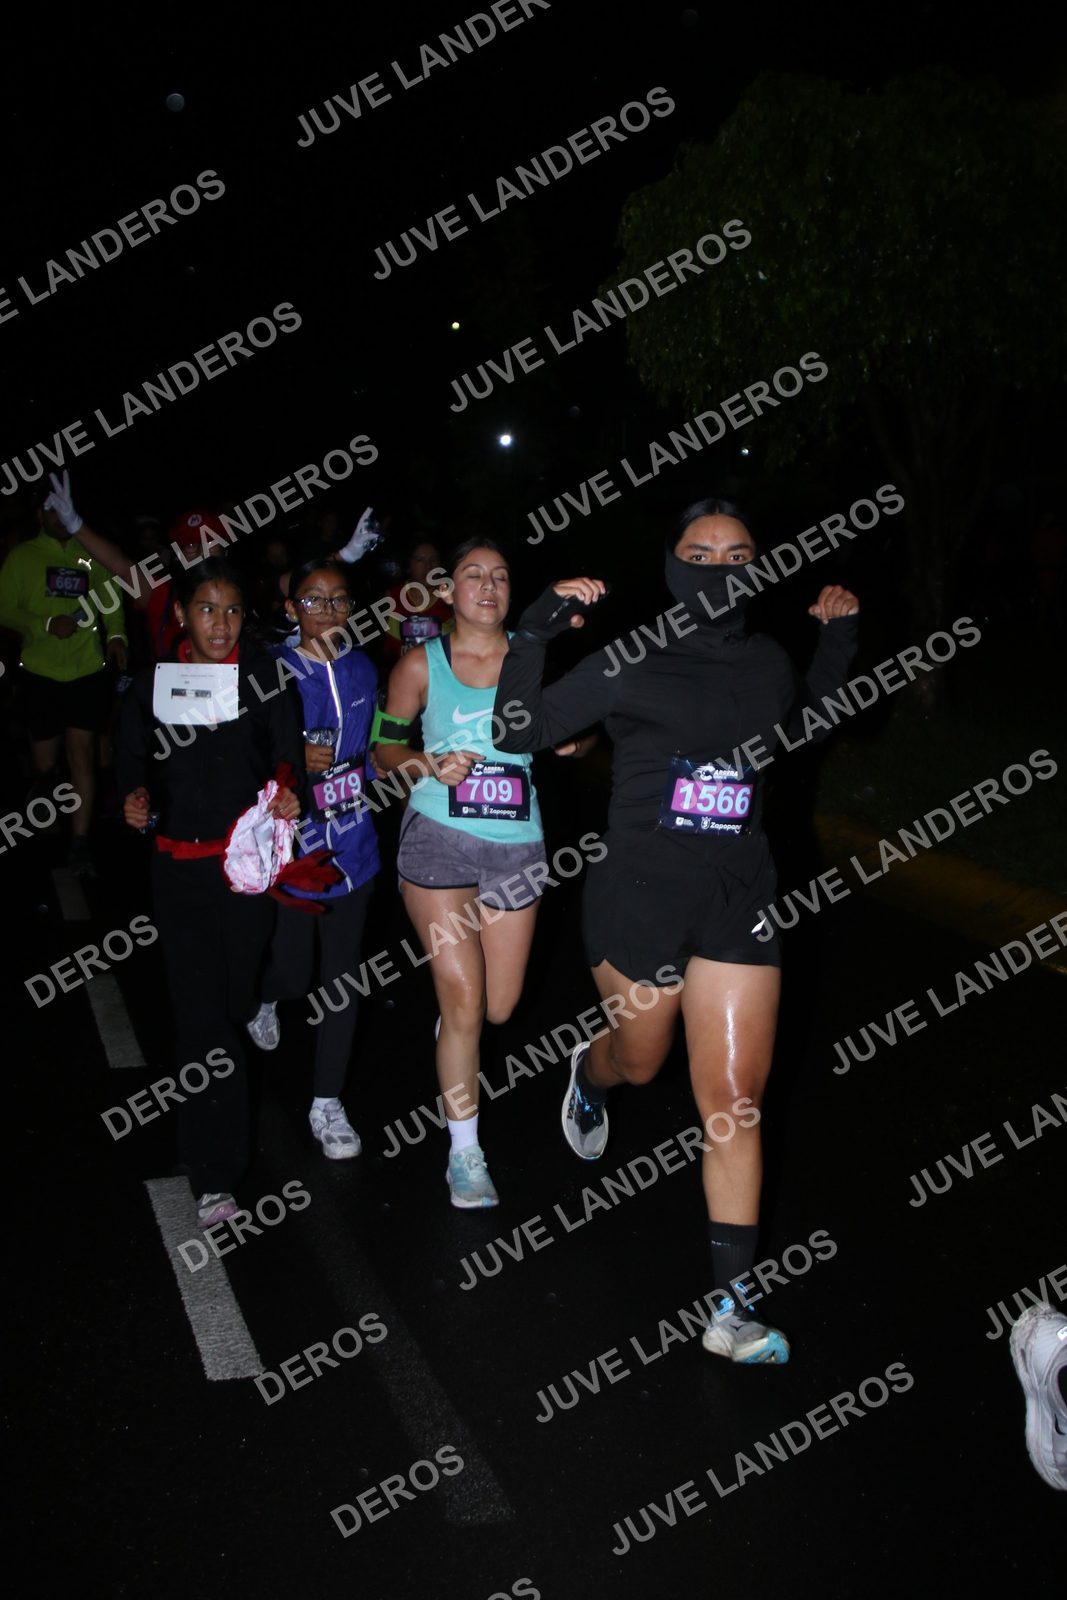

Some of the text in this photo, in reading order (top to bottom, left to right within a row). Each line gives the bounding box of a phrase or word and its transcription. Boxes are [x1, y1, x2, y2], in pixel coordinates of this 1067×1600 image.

[323, 772, 362, 805] 879
[465, 779, 513, 803] 709
[679, 783, 751, 816] 1566
